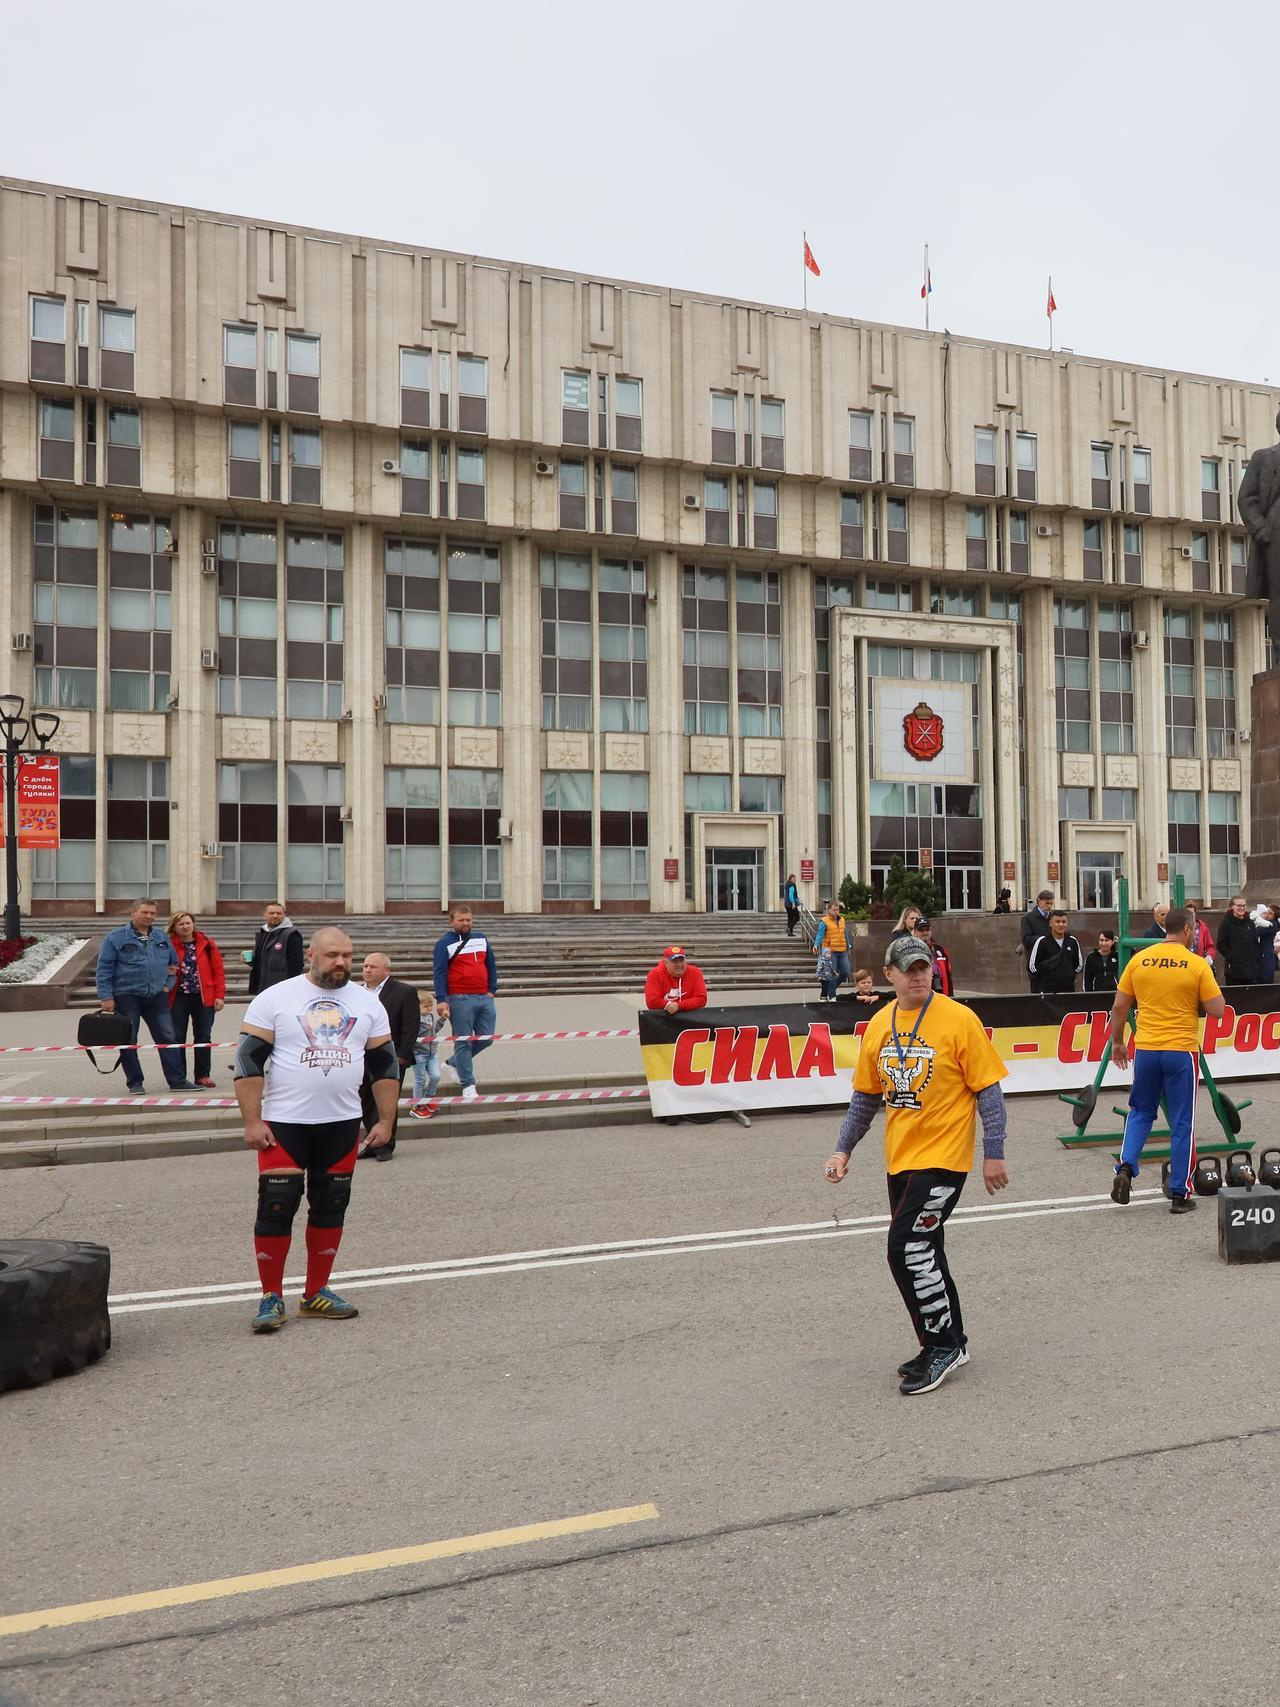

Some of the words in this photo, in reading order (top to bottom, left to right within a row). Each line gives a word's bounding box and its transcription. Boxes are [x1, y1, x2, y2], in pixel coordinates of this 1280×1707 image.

[1141, 958, 1189, 969] СУДЬЯ
[672, 1022, 837, 1087] СИЛА
[1058, 1010, 1137, 1064] СИ
[301, 1050, 351, 1063] НАЦИЯ
[309, 1059, 343, 1068] МИРА
[1206, 1171, 1219, 1181] 24
[1230, 1207, 1276, 1227] 240
